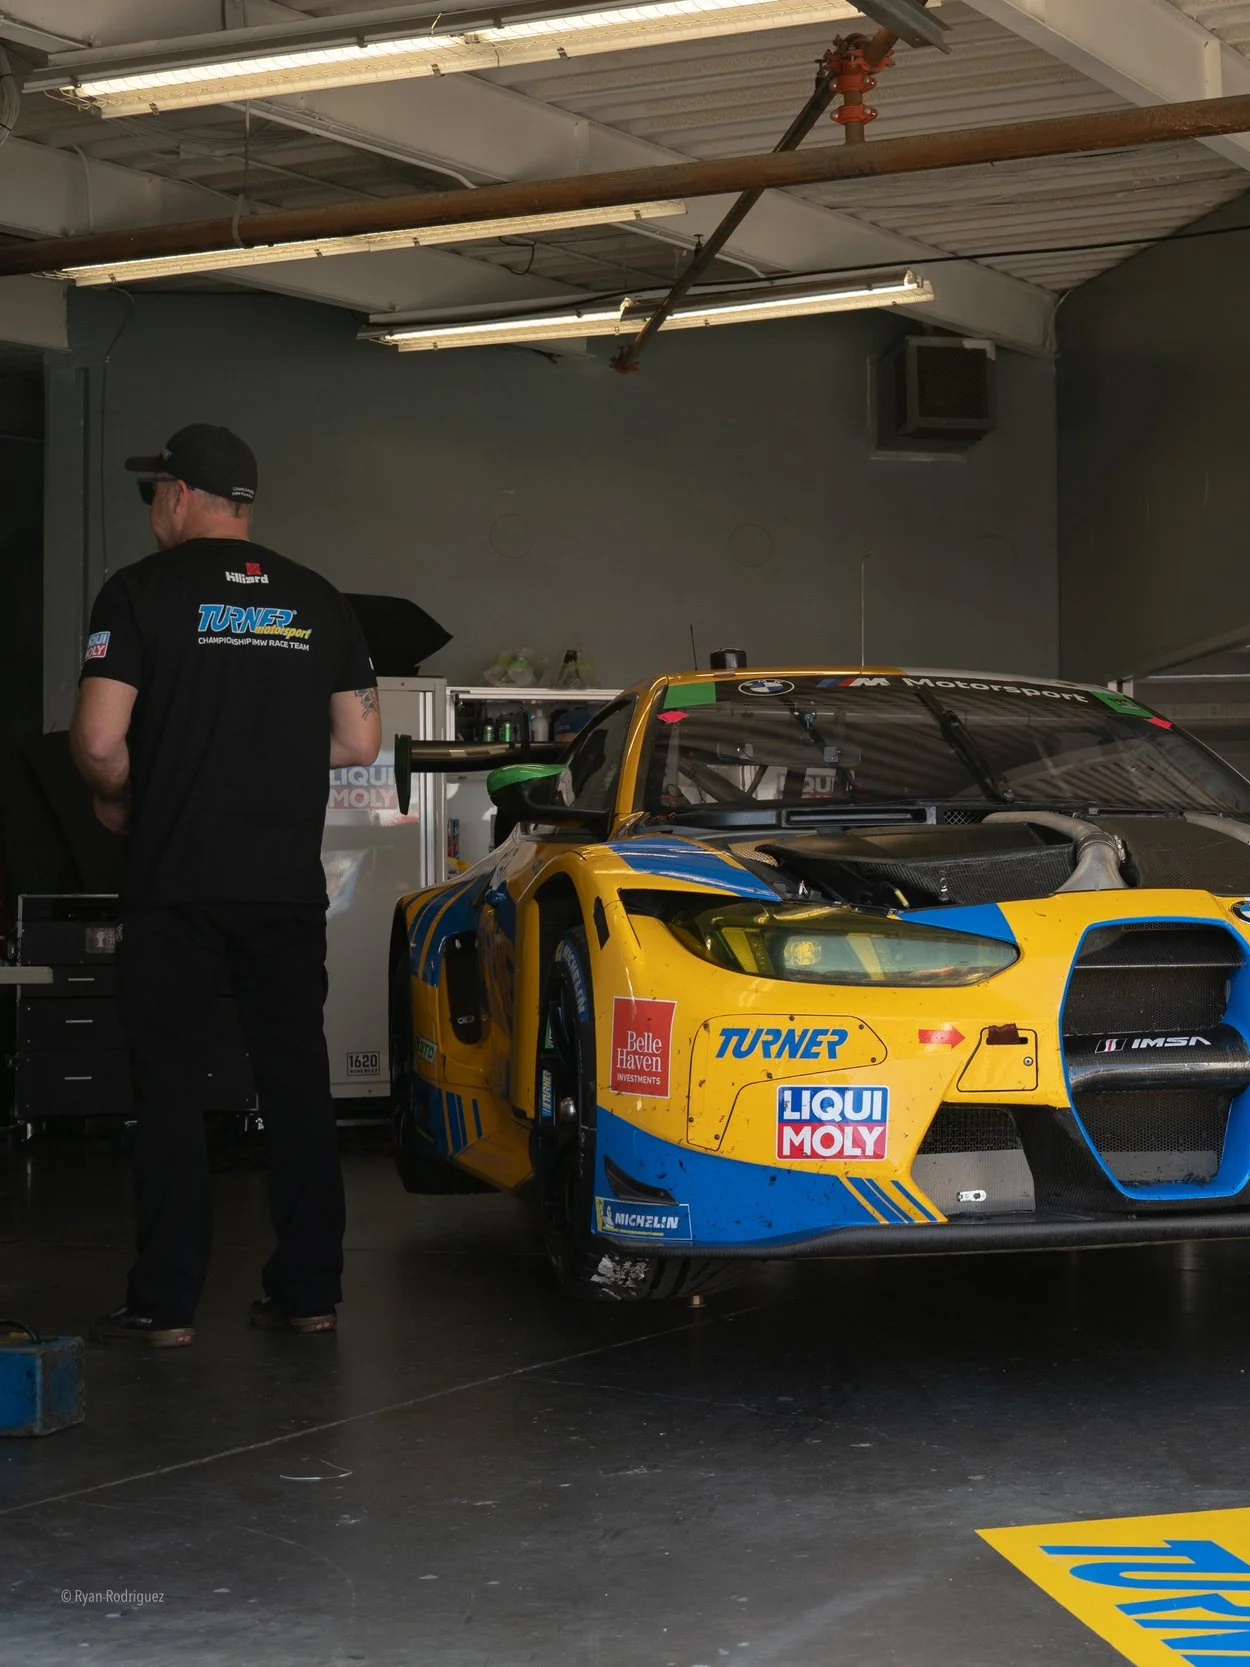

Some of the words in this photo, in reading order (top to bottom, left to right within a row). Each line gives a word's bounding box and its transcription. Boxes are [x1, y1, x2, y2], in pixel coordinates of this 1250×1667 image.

[255, 625, 312, 640] motorsport
[269, 640, 289, 649] RACE
[289, 642, 310, 651] TEAM
[901, 677, 1089, 703] Motorsport
[329, 788, 396, 808] MOLY
[627, 1031, 662, 1055] Belle
[716, 1028, 848, 1059] TURNER
[1131, 1036, 1212, 1049] IMSA
[349, 1054, 378, 1068] 1620
[616, 1048, 662, 1073] Haven
[616, 1074, 661, 1085] INVESTMENTS
[783, 1090, 882, 1122] LIQUI
[782, 1125, 884, 1156] MOLY
[615, 1212, 679, 1229] MICHELIN
